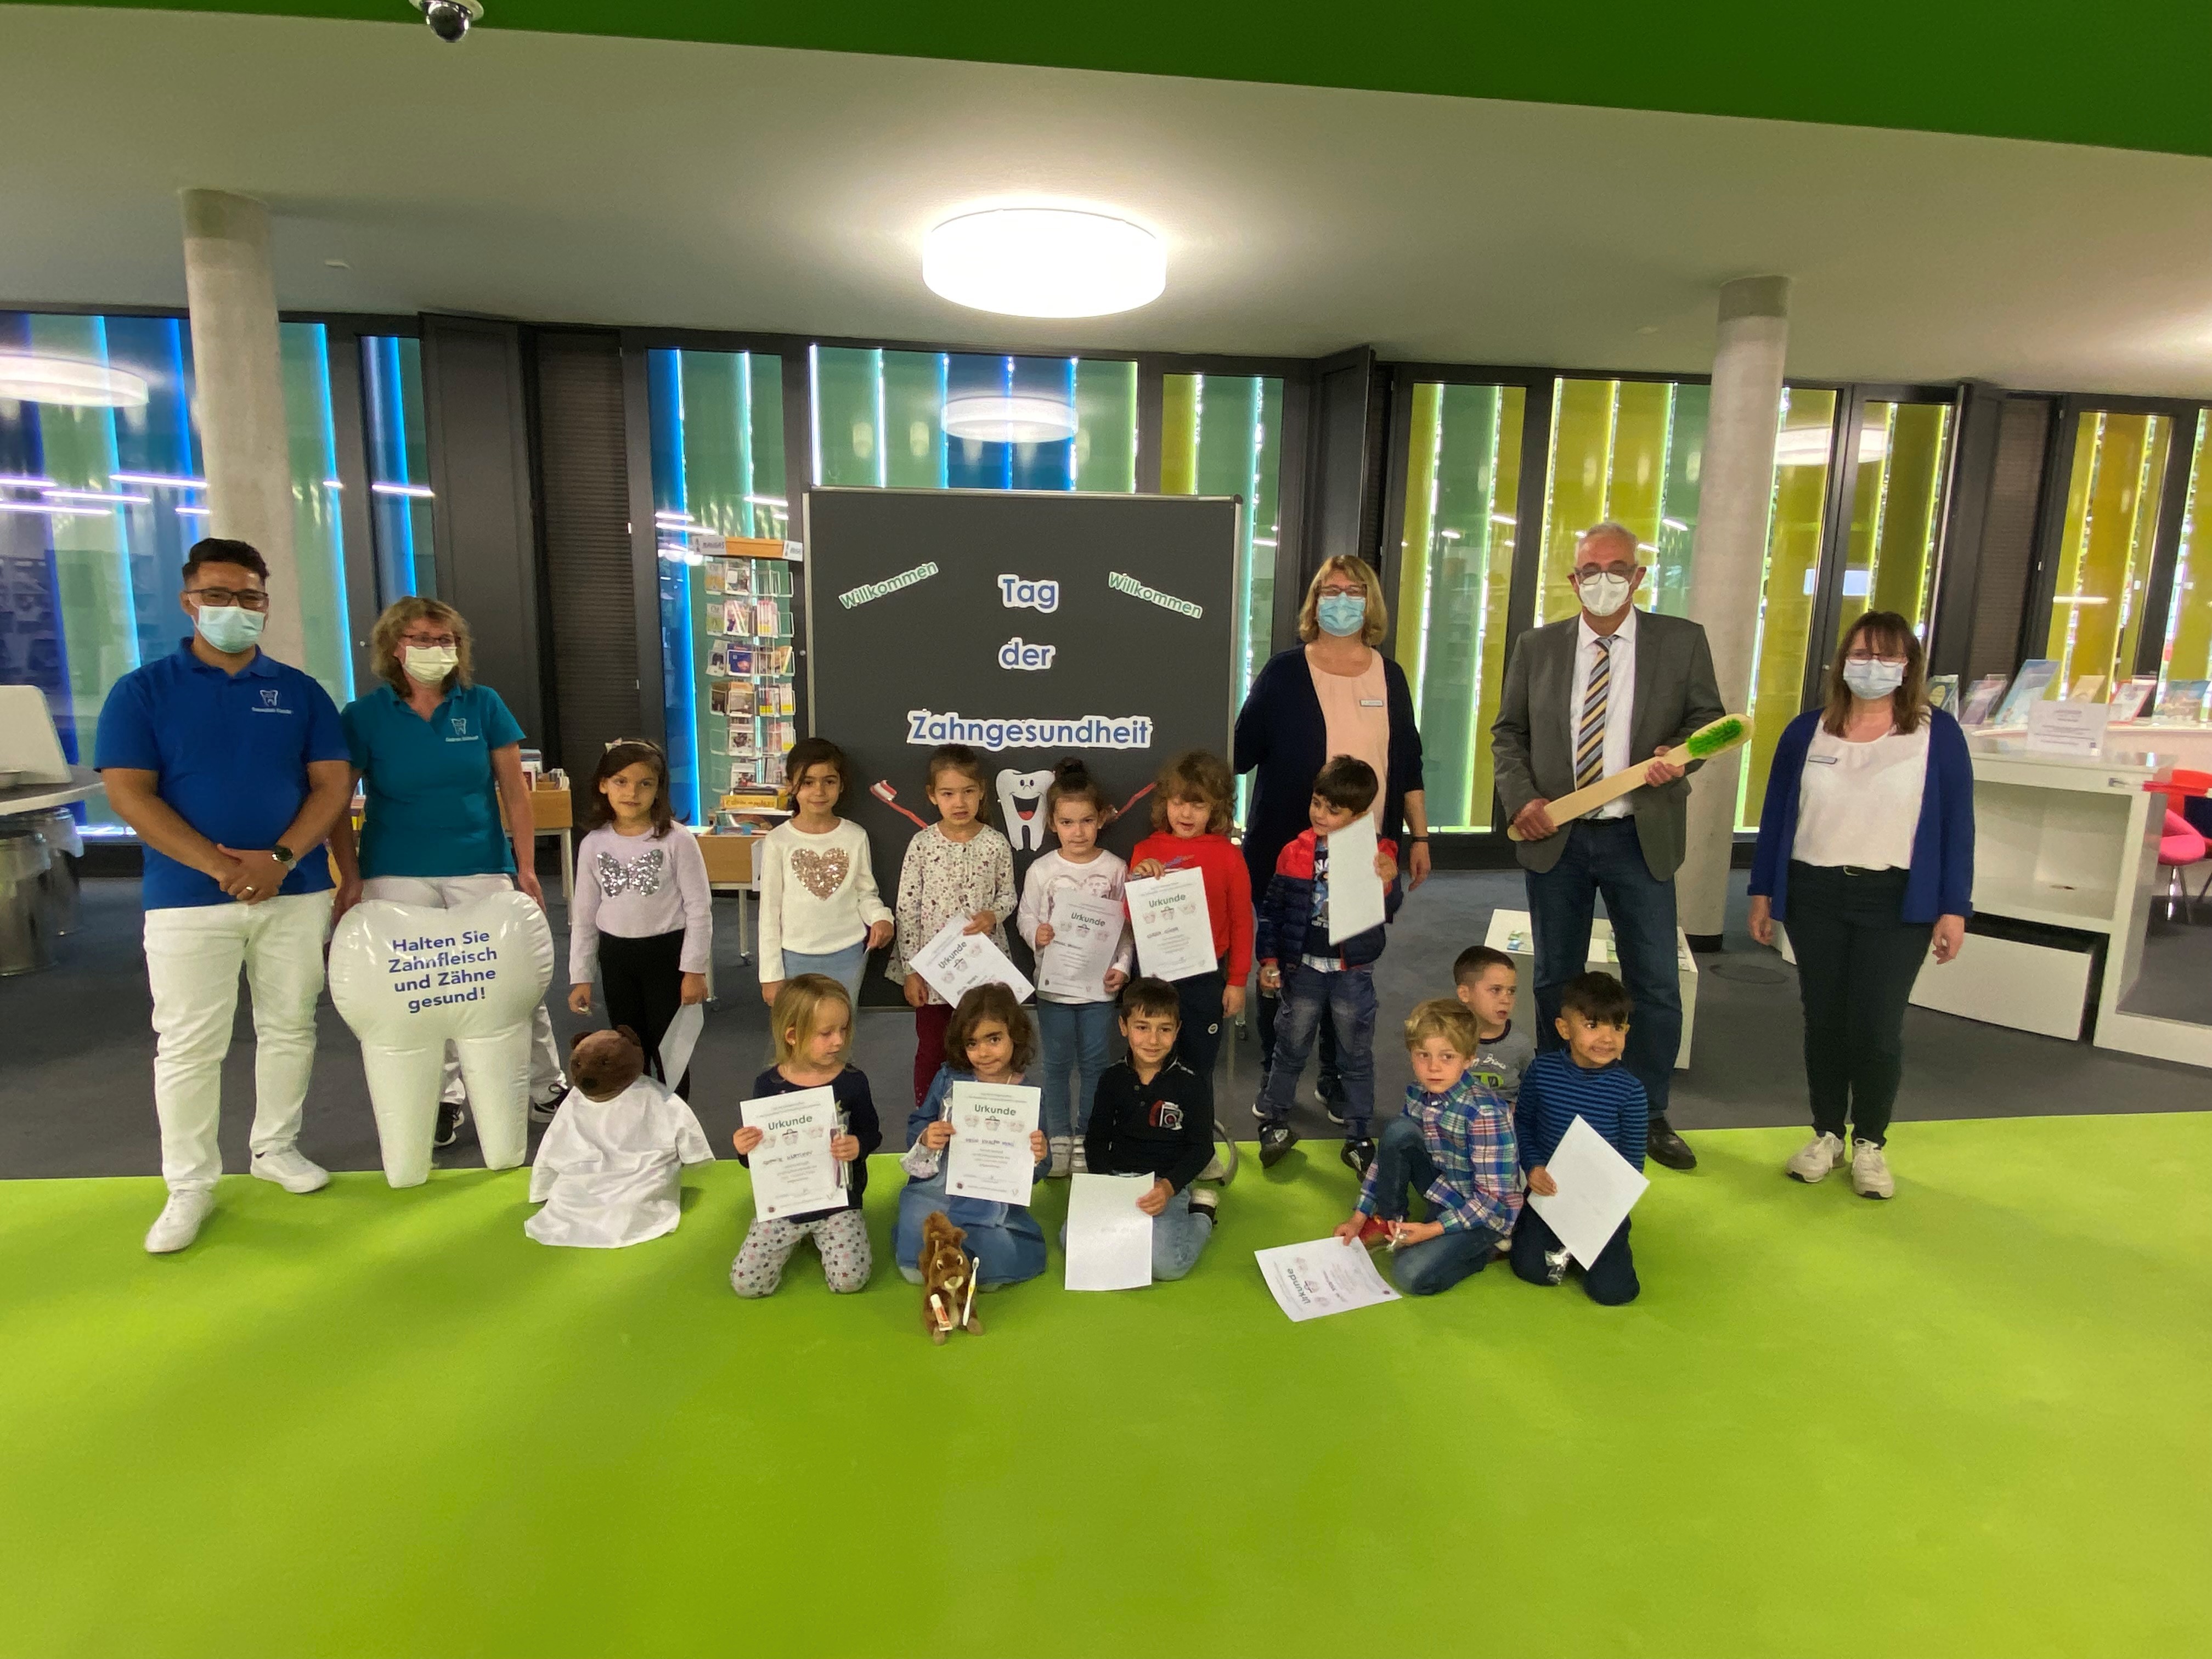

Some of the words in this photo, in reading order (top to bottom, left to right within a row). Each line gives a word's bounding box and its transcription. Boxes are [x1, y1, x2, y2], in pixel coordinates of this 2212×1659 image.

[840, 563, 937, 608] Willkommen
[1003, 578, 1056, 609] Tag
[1109, 573, 1201, 617] Willkommen
[1001, 641, 1051, 667] der
[911, 715, 1148, 747] Zahngesundheit
[1148, 893, 1186, 908] Urkunde
[1071, 912, 1106, 927] Urkunde
[392, 936, 456, 952] Halten
[462, 930, 490, 945] Sie
[388, 947, 498, 973] Zahnfleisch
[938, 940, 968, 969] Urkunde
[394, 974, 431, 992] und
[438, 969, 496, 987] Zähne
[408, 987, 486, 1014] gesund!
[768, 1114, 813, 1131] Urkunde
[975, 1103, 1017, 1116] Urkunde
[1287, 1267, 1311, 1304] Urkunde
